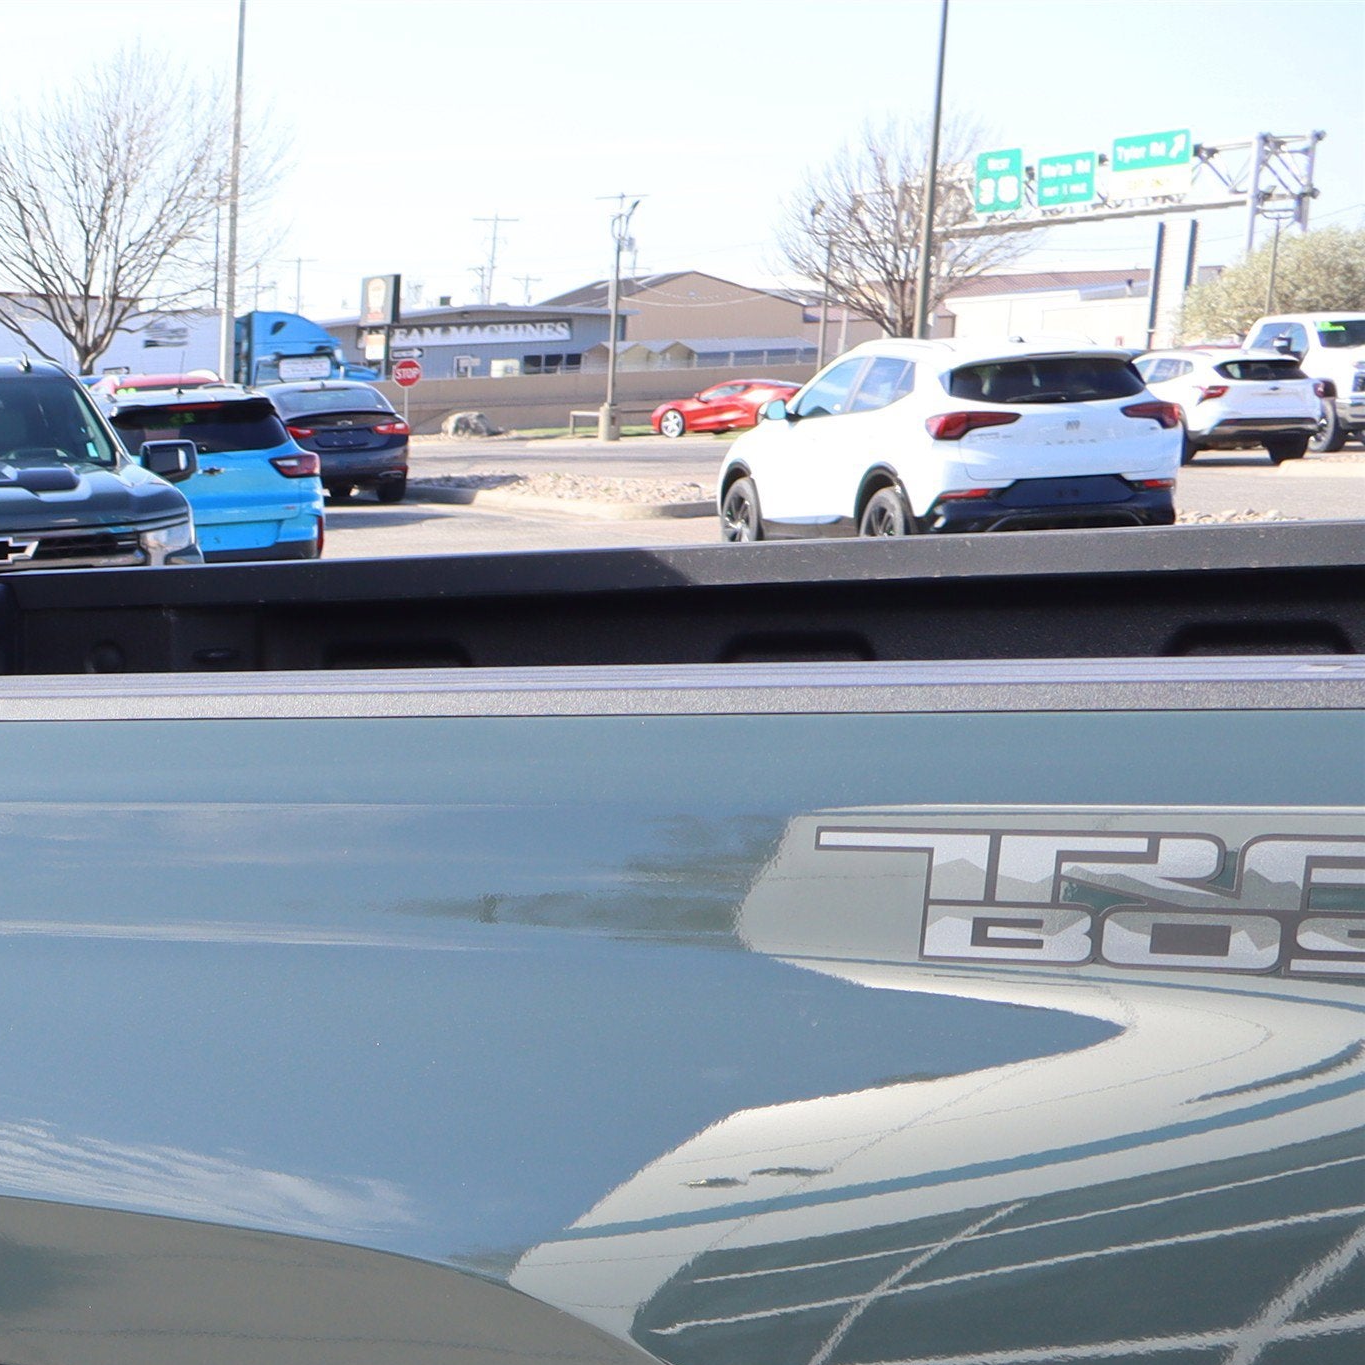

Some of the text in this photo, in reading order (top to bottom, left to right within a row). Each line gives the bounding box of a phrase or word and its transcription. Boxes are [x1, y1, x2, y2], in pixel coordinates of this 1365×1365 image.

[1150, 142, 1166, 156] Rd
[448, 320, 570, 342] MACHINES
[394, 366, 421, 379] STOP
